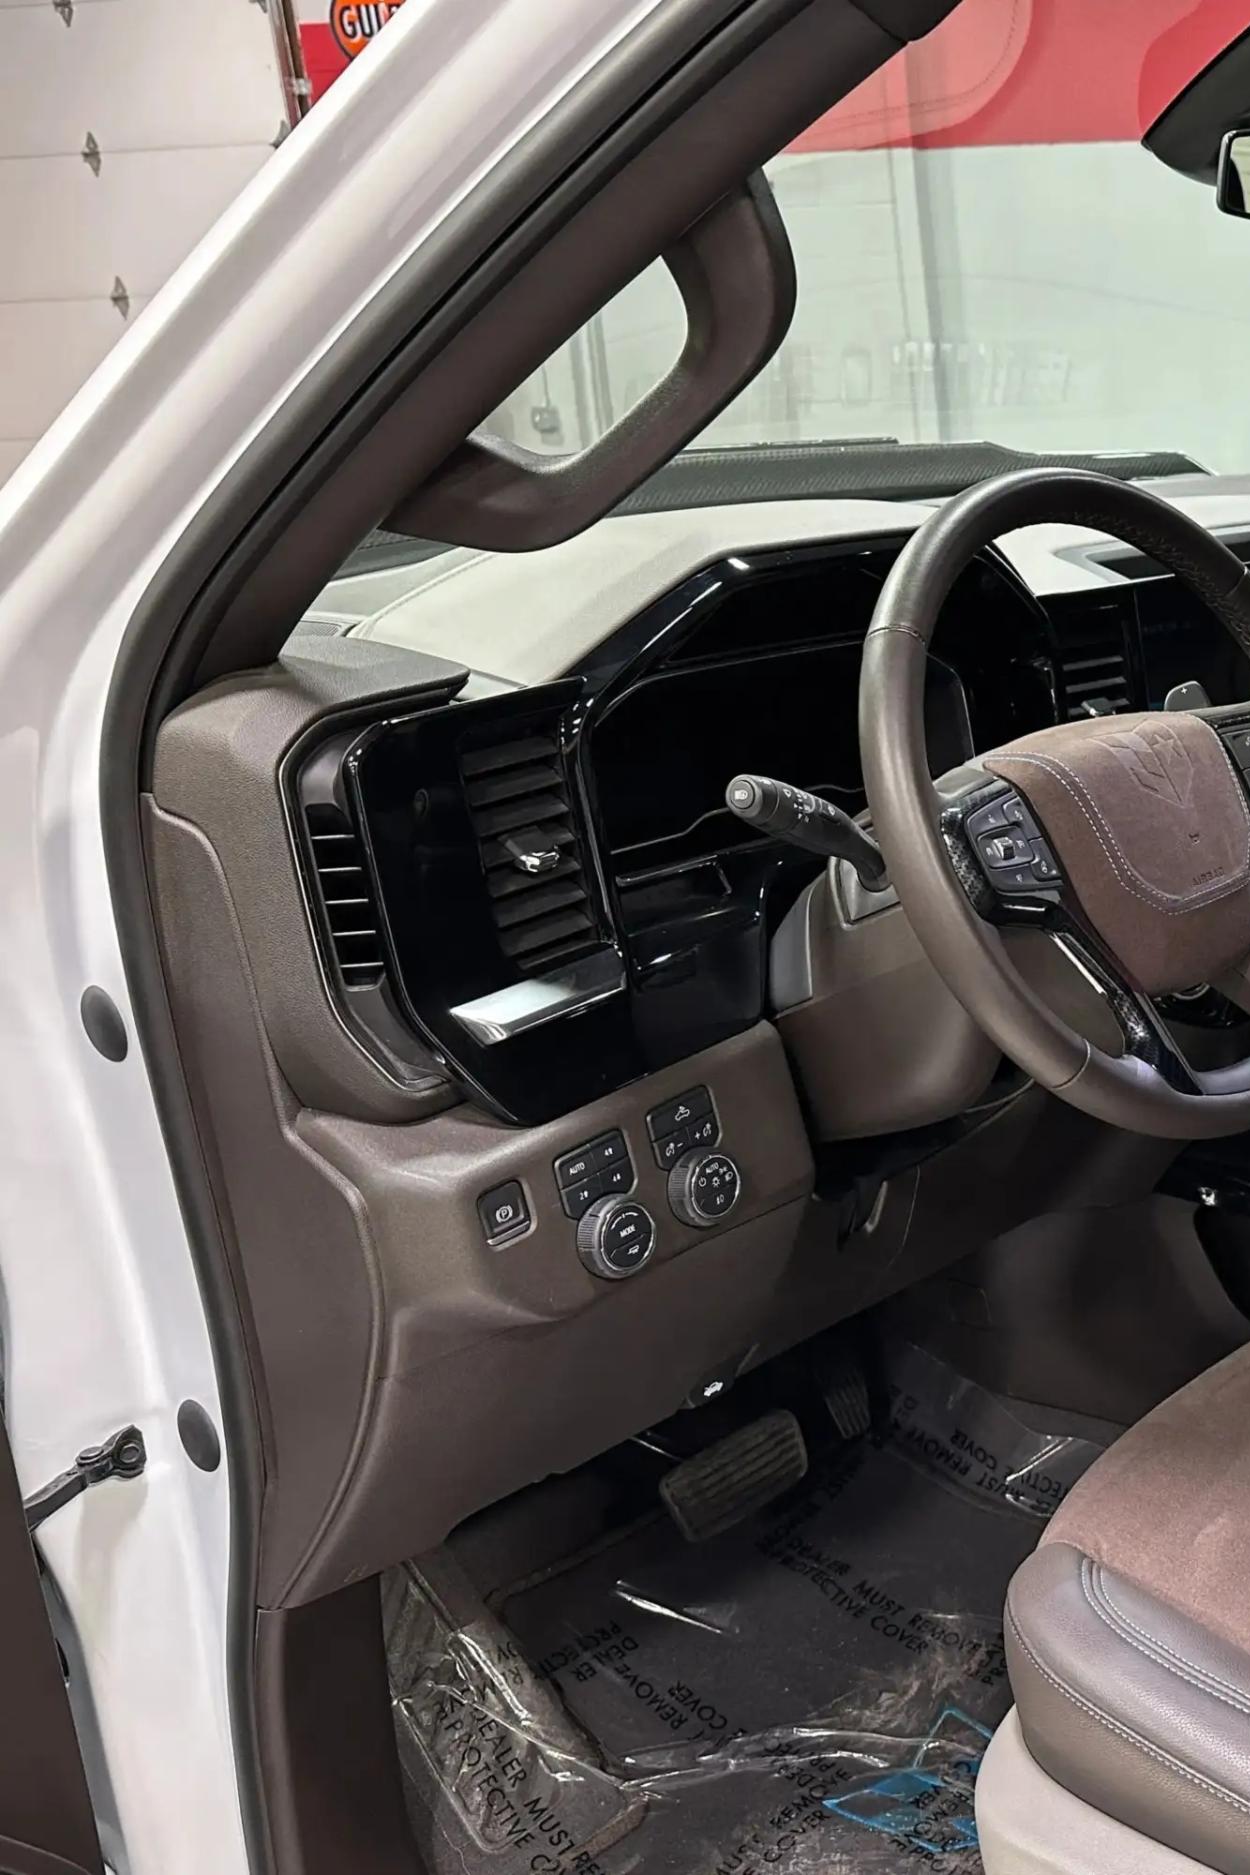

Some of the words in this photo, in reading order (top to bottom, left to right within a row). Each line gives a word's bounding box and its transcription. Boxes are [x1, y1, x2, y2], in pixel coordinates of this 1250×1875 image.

[569, 1161, 586, 1176] AUTO
[705, 1162, 720, 1175] AUTO
[620, 1225, 636, 1238] MODE
[853, 1579, 905, 1616] MUST
[870, 1615, 928, 1655] COVER
[667, 1681, 728, 1729] COVER
[444, 1721, 535, 1849] PROTECTIVE
[523, 1796, 575, 1856] MUST
